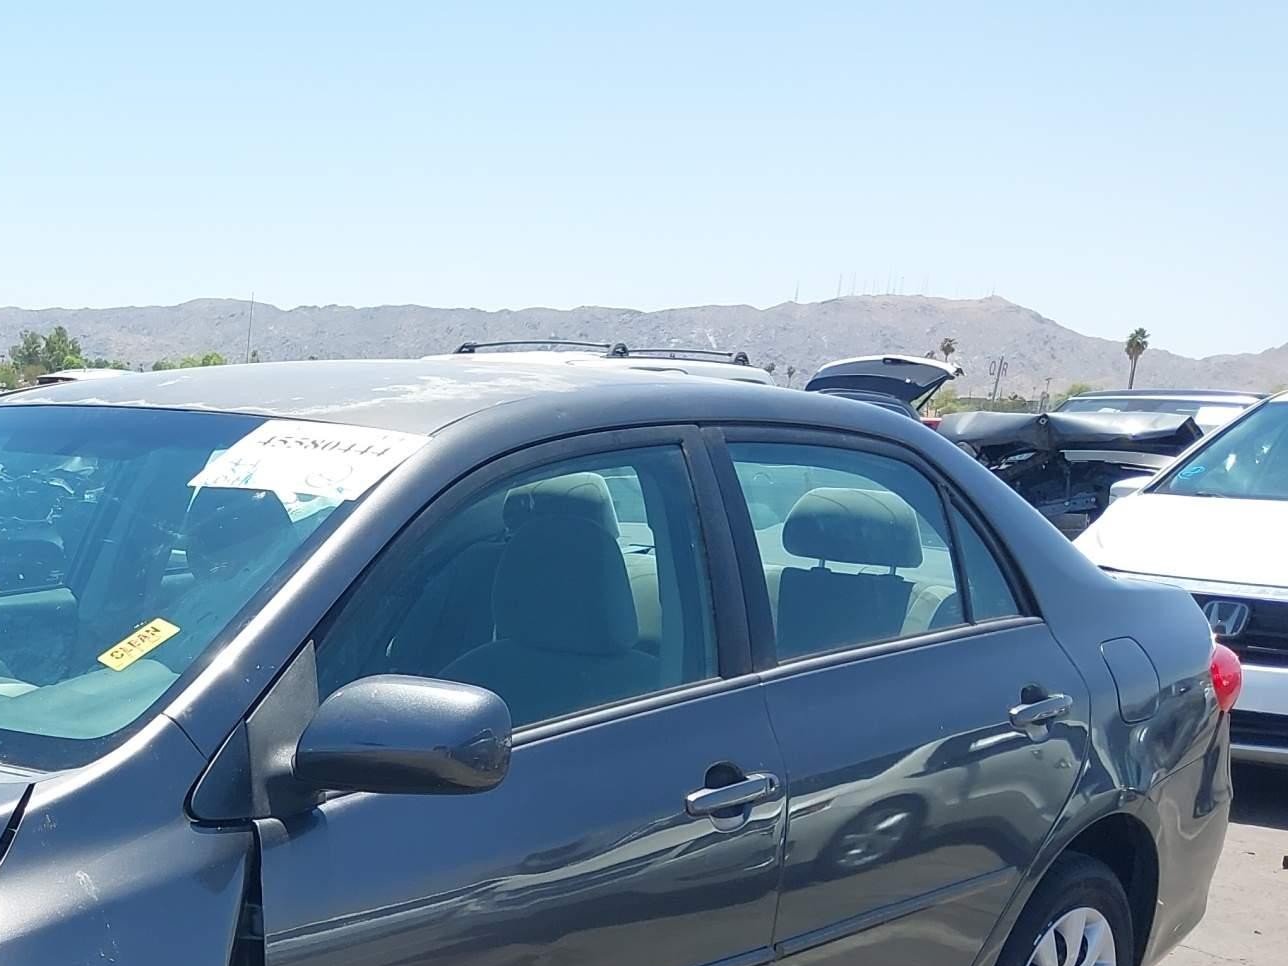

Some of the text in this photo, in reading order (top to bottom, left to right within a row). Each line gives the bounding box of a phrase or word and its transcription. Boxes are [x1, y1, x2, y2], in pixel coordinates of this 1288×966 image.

[988, 360, 1009, 377] Q R
[256, 435, 391, 457] 45580444
[110, 626, 161, 660] CLEAN
